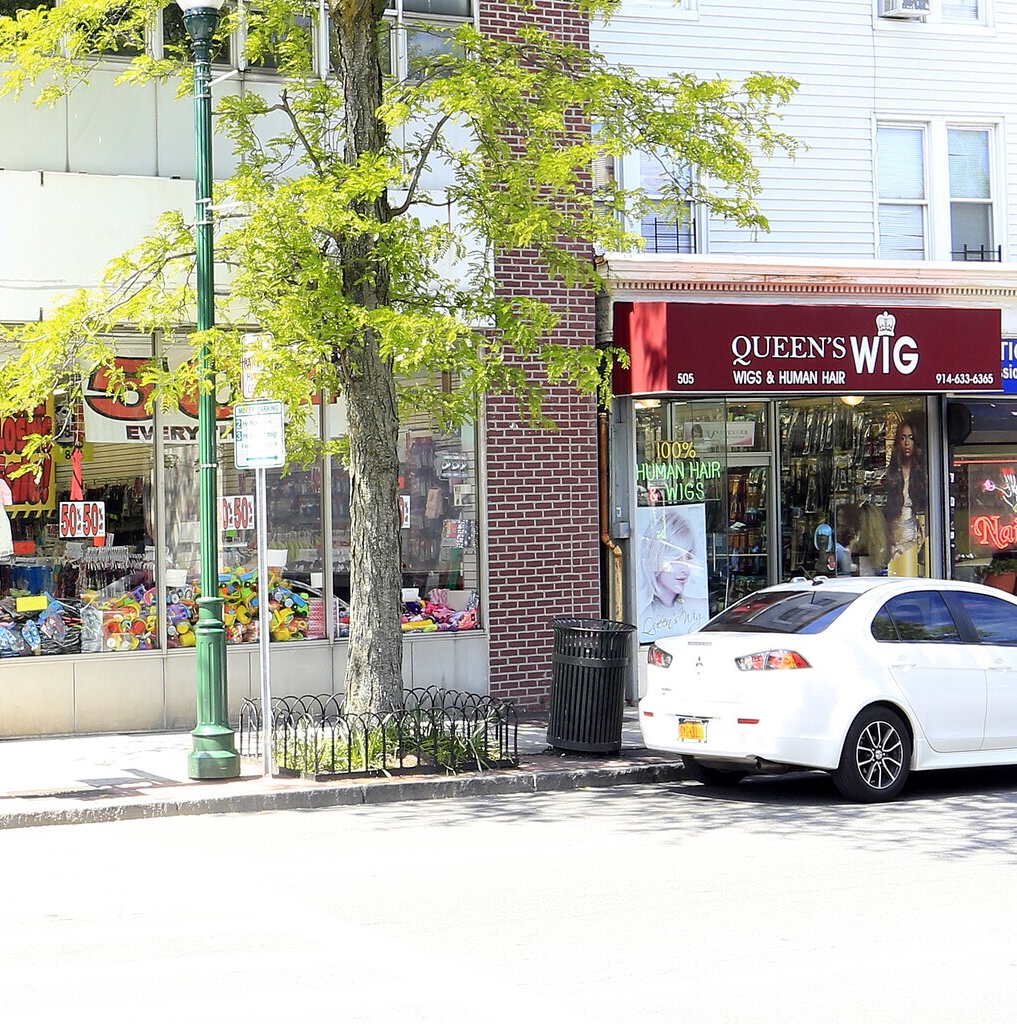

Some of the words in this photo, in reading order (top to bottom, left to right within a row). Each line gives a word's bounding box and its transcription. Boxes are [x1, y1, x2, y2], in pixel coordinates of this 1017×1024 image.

[731, 335, 847, 366] QUEEN'S
[850, 335, 919, 375] WIG
[677, 372, 694, 385] 505
[733, 370, 763, 385] WIGS
[766, 371, 776, 385] &
[779, 371, 818, 385] HUMAN
[821, 371, 846, 385] HAIR
[935, 373, 994, 384] 914-633-6365
[657, 441, 696, 459] 100%
[636, 462, 684, 481] HUMAN
[689, 461, 721, 479] HAIR
[649, 487, 659, 502] &
[665, 482, 705, 501] WIGS
